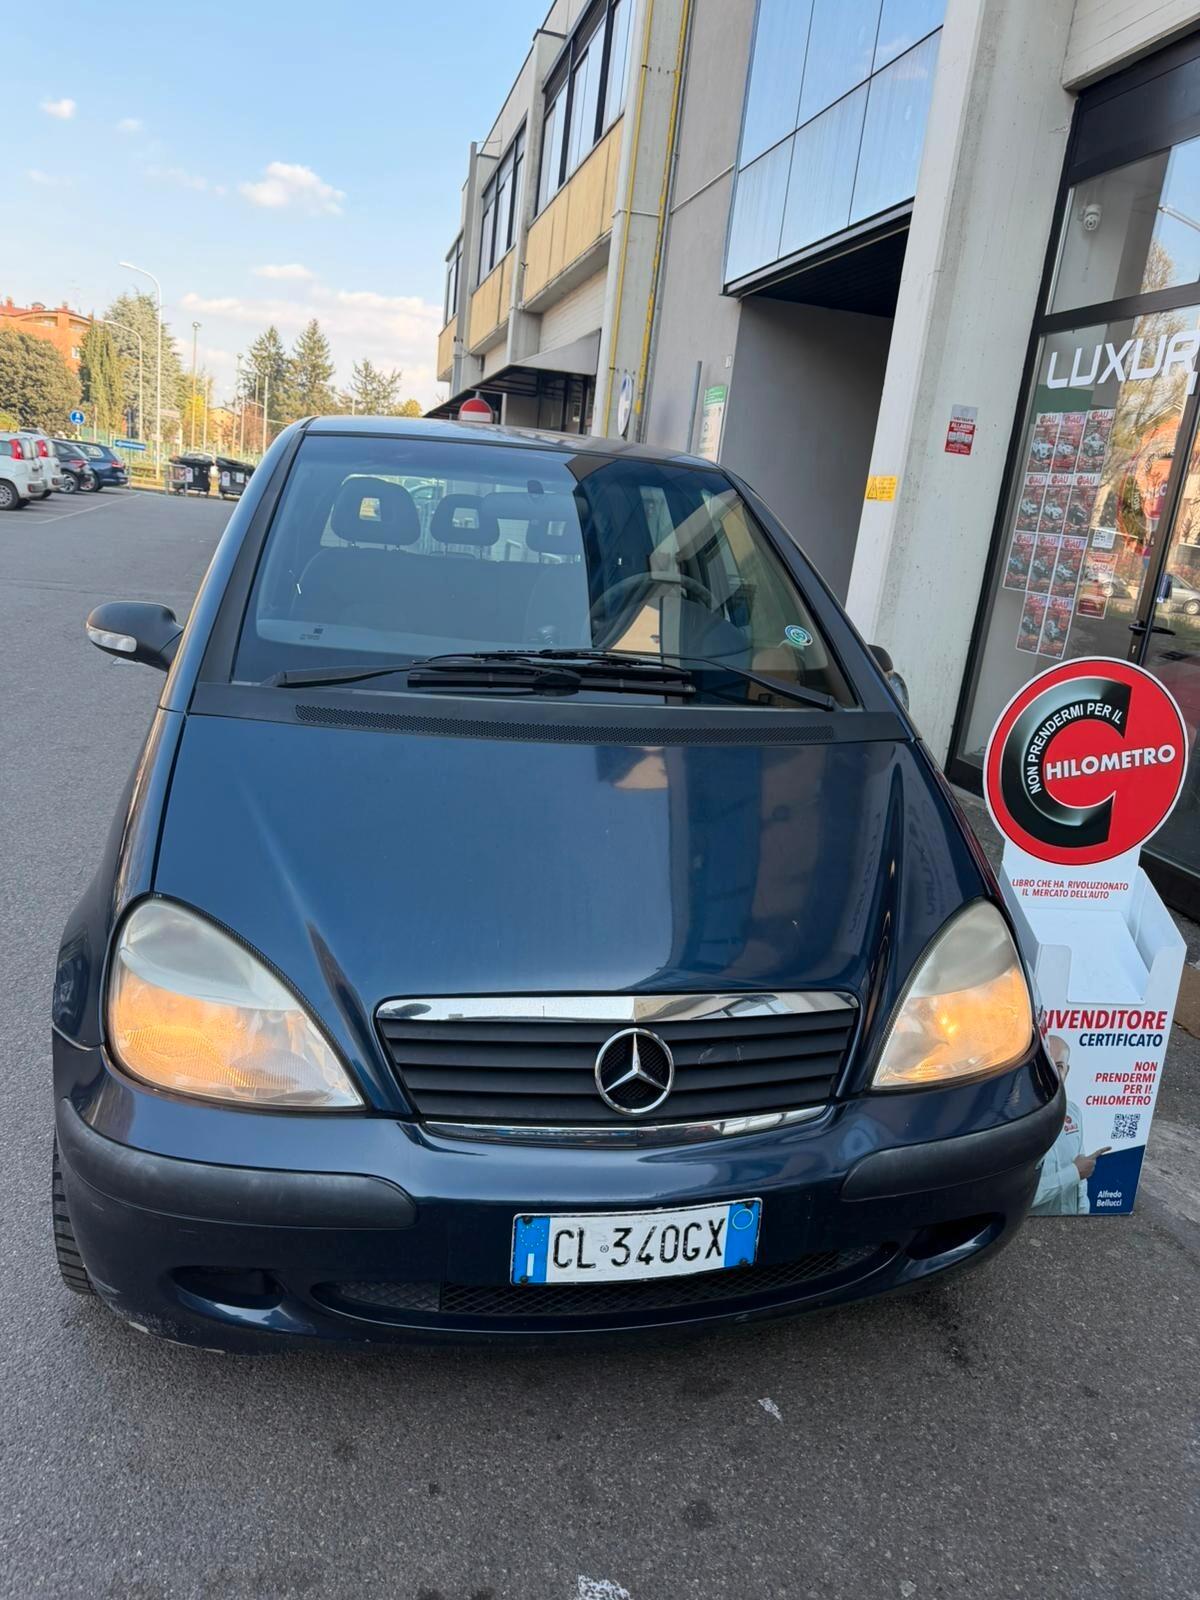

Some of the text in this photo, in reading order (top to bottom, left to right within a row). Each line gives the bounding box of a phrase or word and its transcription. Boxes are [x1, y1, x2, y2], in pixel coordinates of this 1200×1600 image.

[1027, 702, 1122, 795] NON PRENDERMI PER IL
[1012, 878, 1128, 891] LIBRO CHE HA RIVOLUZIONATO
[1022, 889, 1109, 899] IL MERCATO DELL'AUTO
[1079, 1033, 1163, 1047] CERTIFICATO
[1134, 1061, 1158, 1072] NON
[1095, 1073, 1156, 1083] PRENDERMI
[1123, 1084, 1143, 1094] PER
[1085, 1095, 1151, 1106] CHILOMETRO
[1097, 1190, 1122, 1199] Alfredo
[1096, 1198, 1122, 1207] Bellucci
